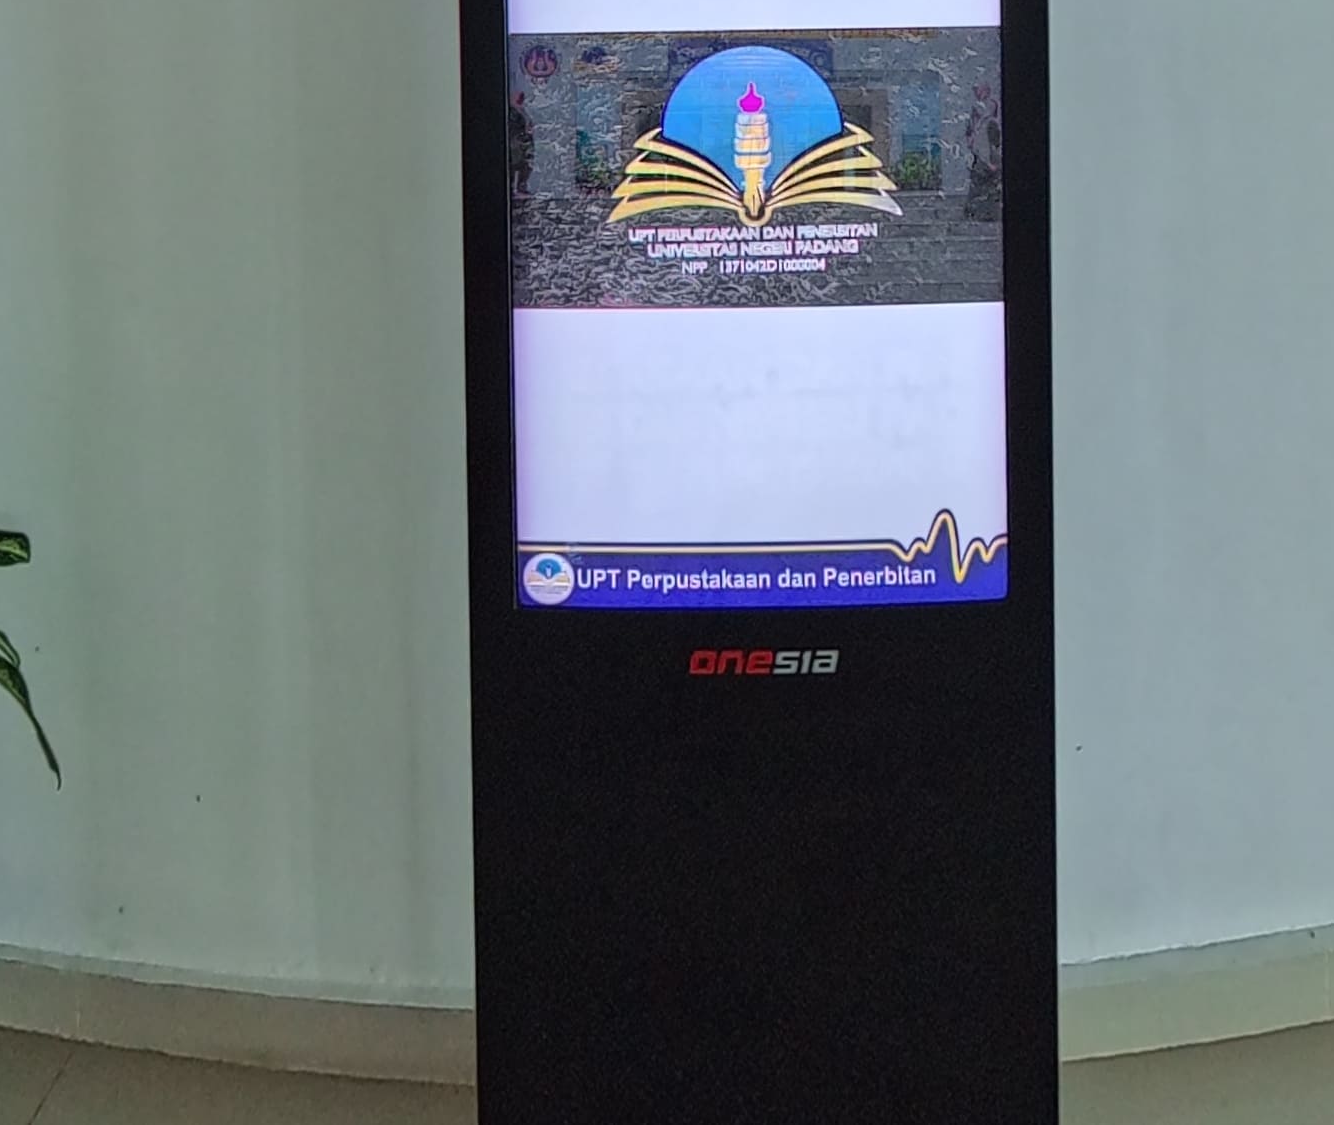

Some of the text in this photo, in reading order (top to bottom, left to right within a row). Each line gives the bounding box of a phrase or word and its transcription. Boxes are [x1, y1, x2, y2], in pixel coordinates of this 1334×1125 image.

[628, 228, 655, 243] UPT
[762, 225, 795, 240] DAN
[795, 239, 859, 255] PADANG
[682, 261, 708, 274] NPP
[576, 568, 620, 590] UPT
[627, 567, 771, 594] Perpustakaan
[777, 567, 817, 589] dan
[823, 565, 937, 588] Penerbitan
[688, 648, 840, 675] onesia
